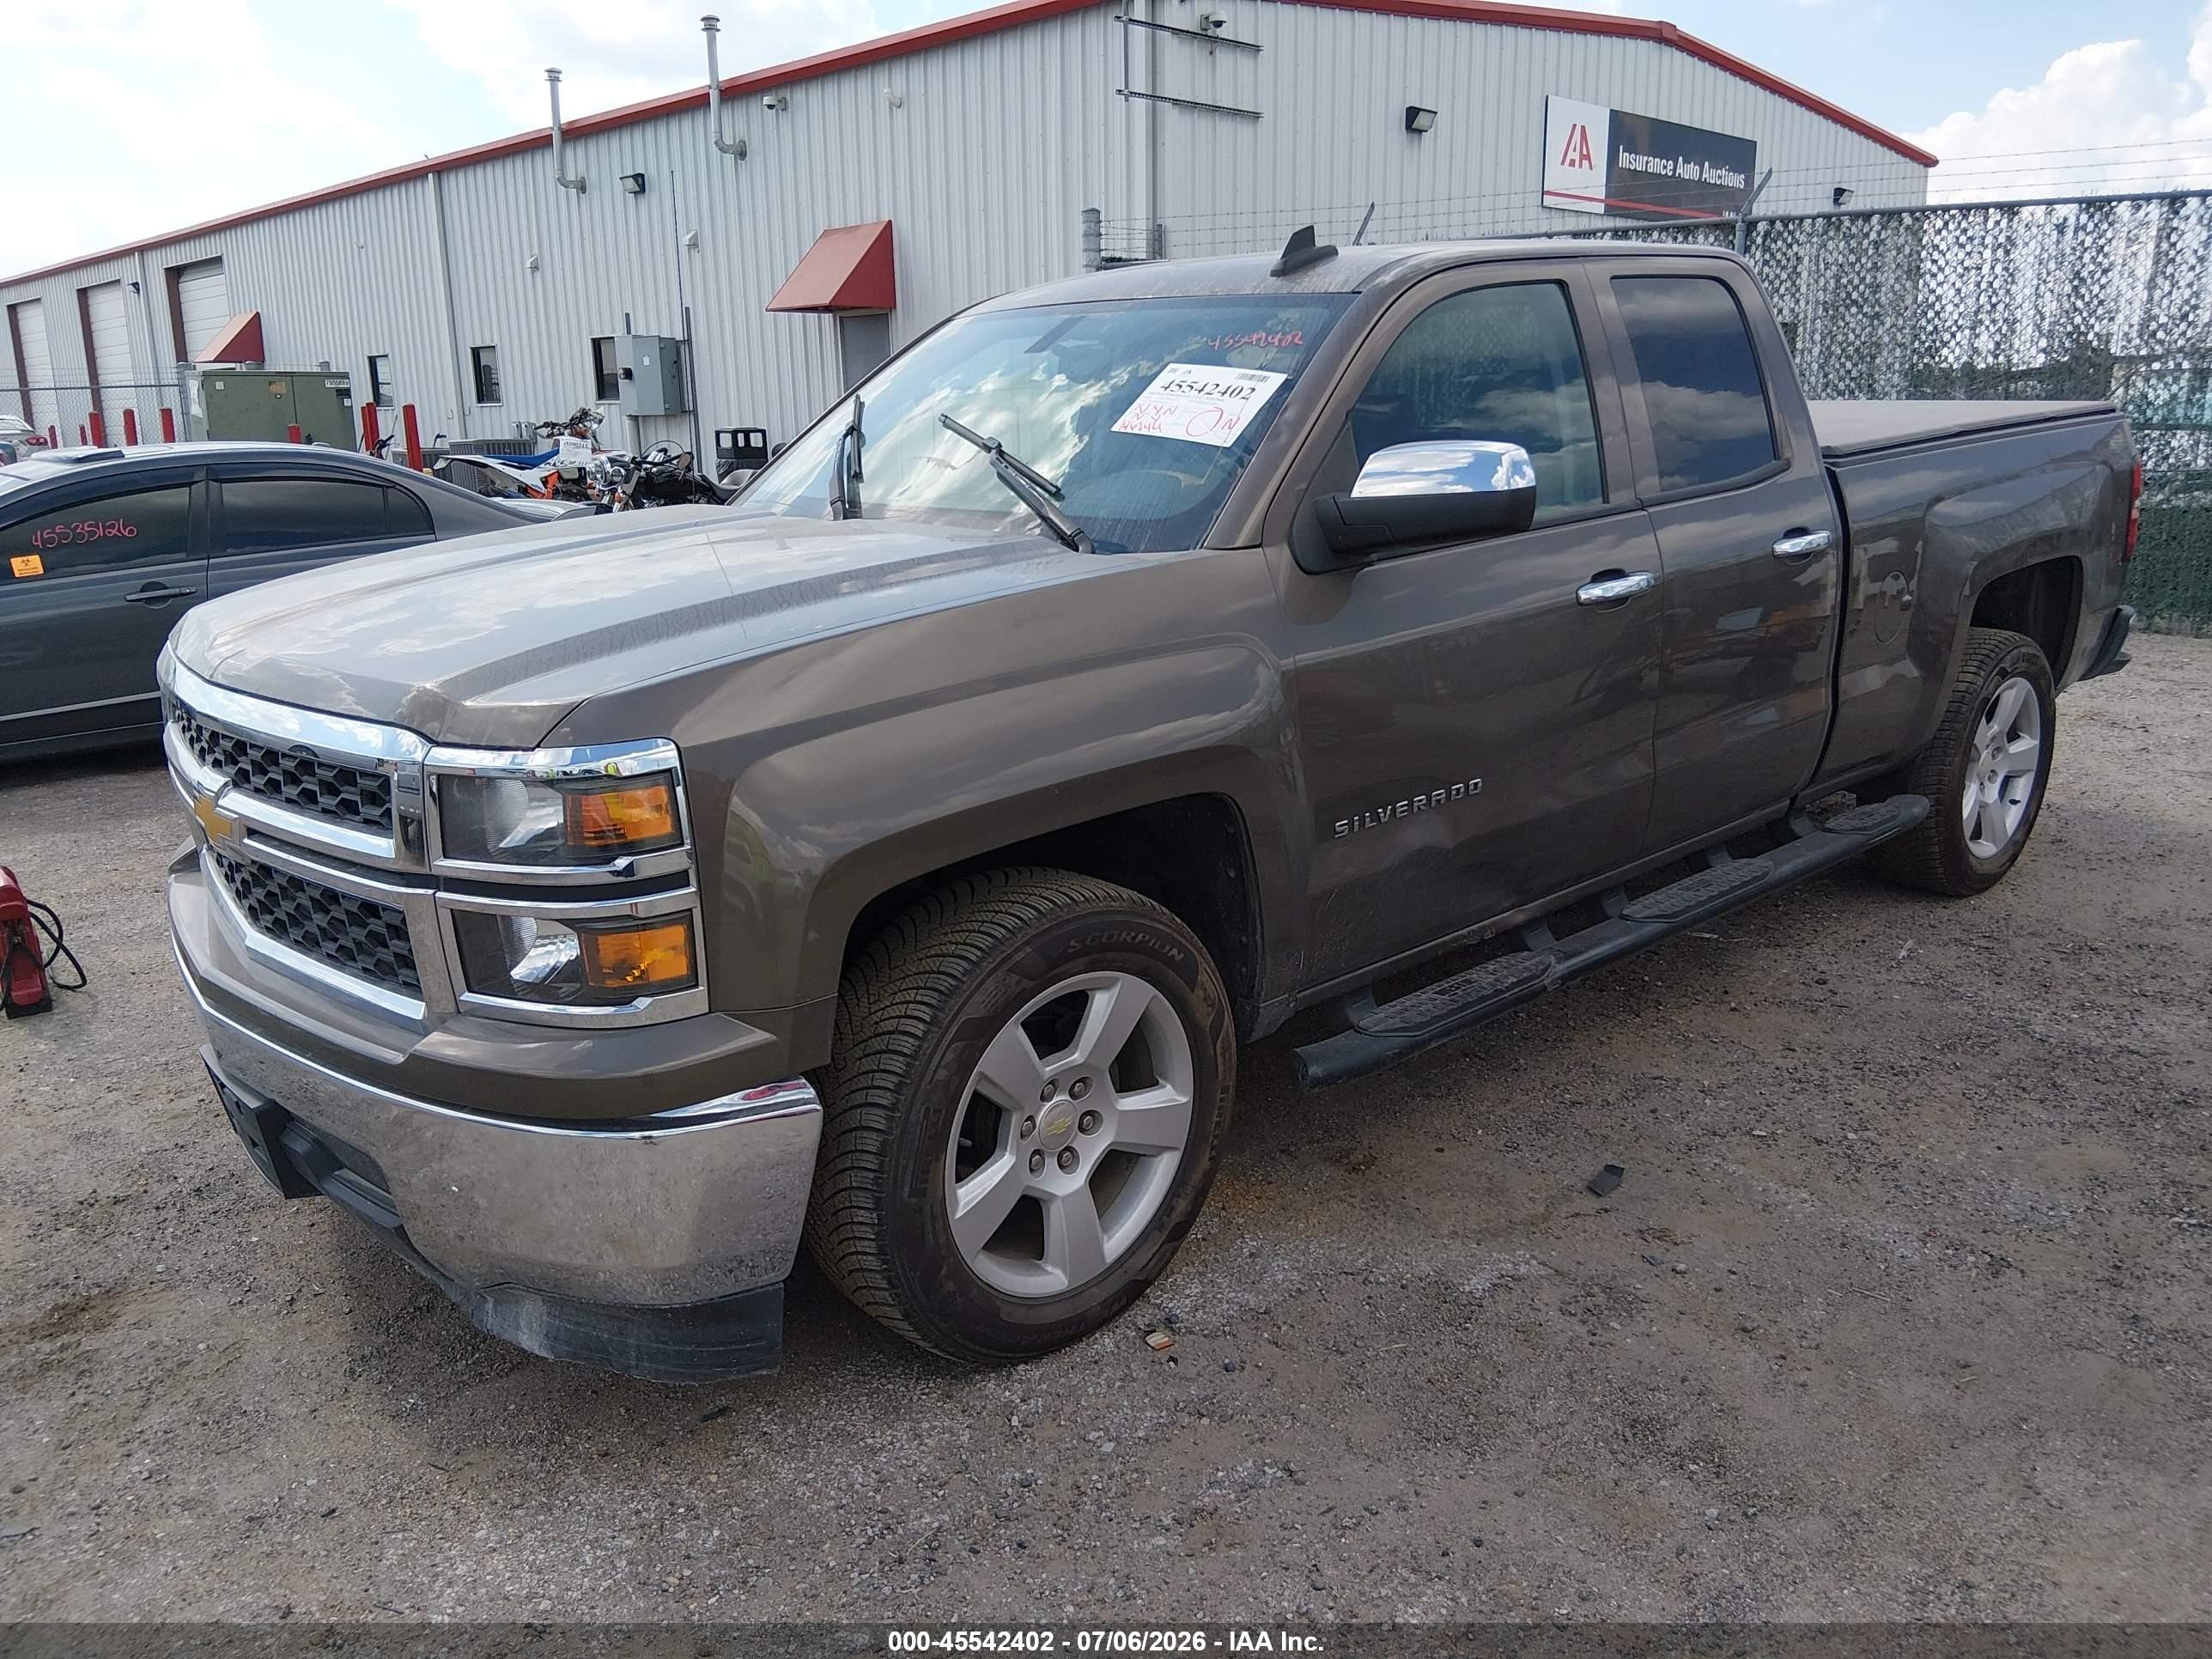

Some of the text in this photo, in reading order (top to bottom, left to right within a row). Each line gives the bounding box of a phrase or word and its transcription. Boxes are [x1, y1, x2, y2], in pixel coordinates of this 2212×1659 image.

[1619, 145, 1745, 190] Insurance Auto Auctions
[1160, 378, 1256, 401] 45542402
[32, 518, 137, 549] 45535126
[1334, 778, 1483, 838] SILVERADO
[1066, 930, 1185, 962] SCORPION
